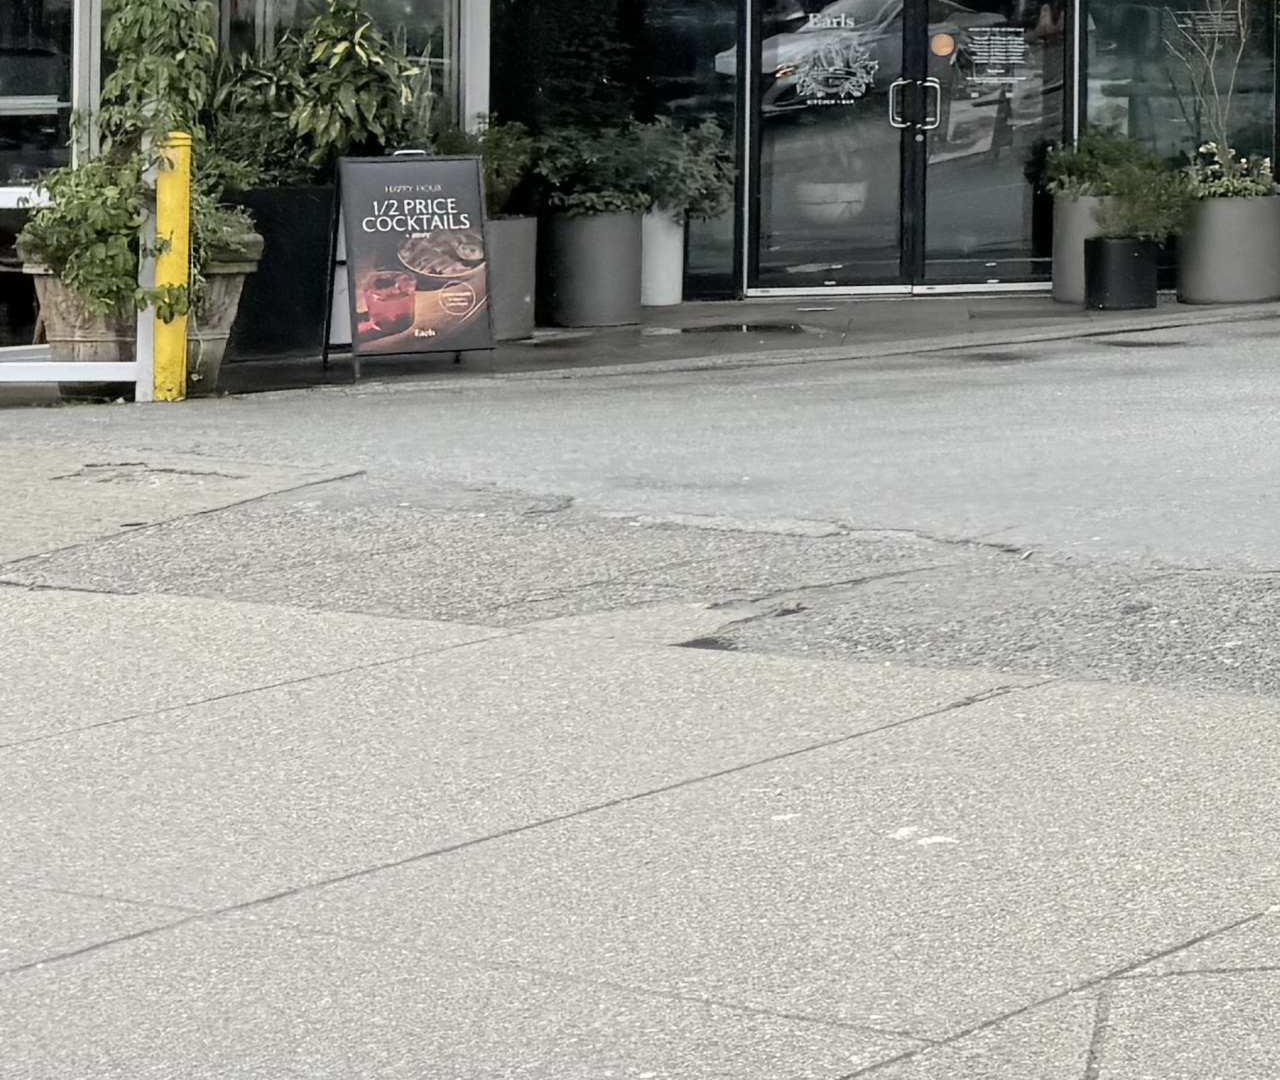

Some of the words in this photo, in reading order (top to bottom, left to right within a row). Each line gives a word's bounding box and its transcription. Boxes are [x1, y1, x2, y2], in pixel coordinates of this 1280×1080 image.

[808, 12, 855, 28] Earls
[373, 200, 400, 216] 1/2
[403, 198, 458, 214] PRICE
[362, 213, 471, 232] COCKTAILS
